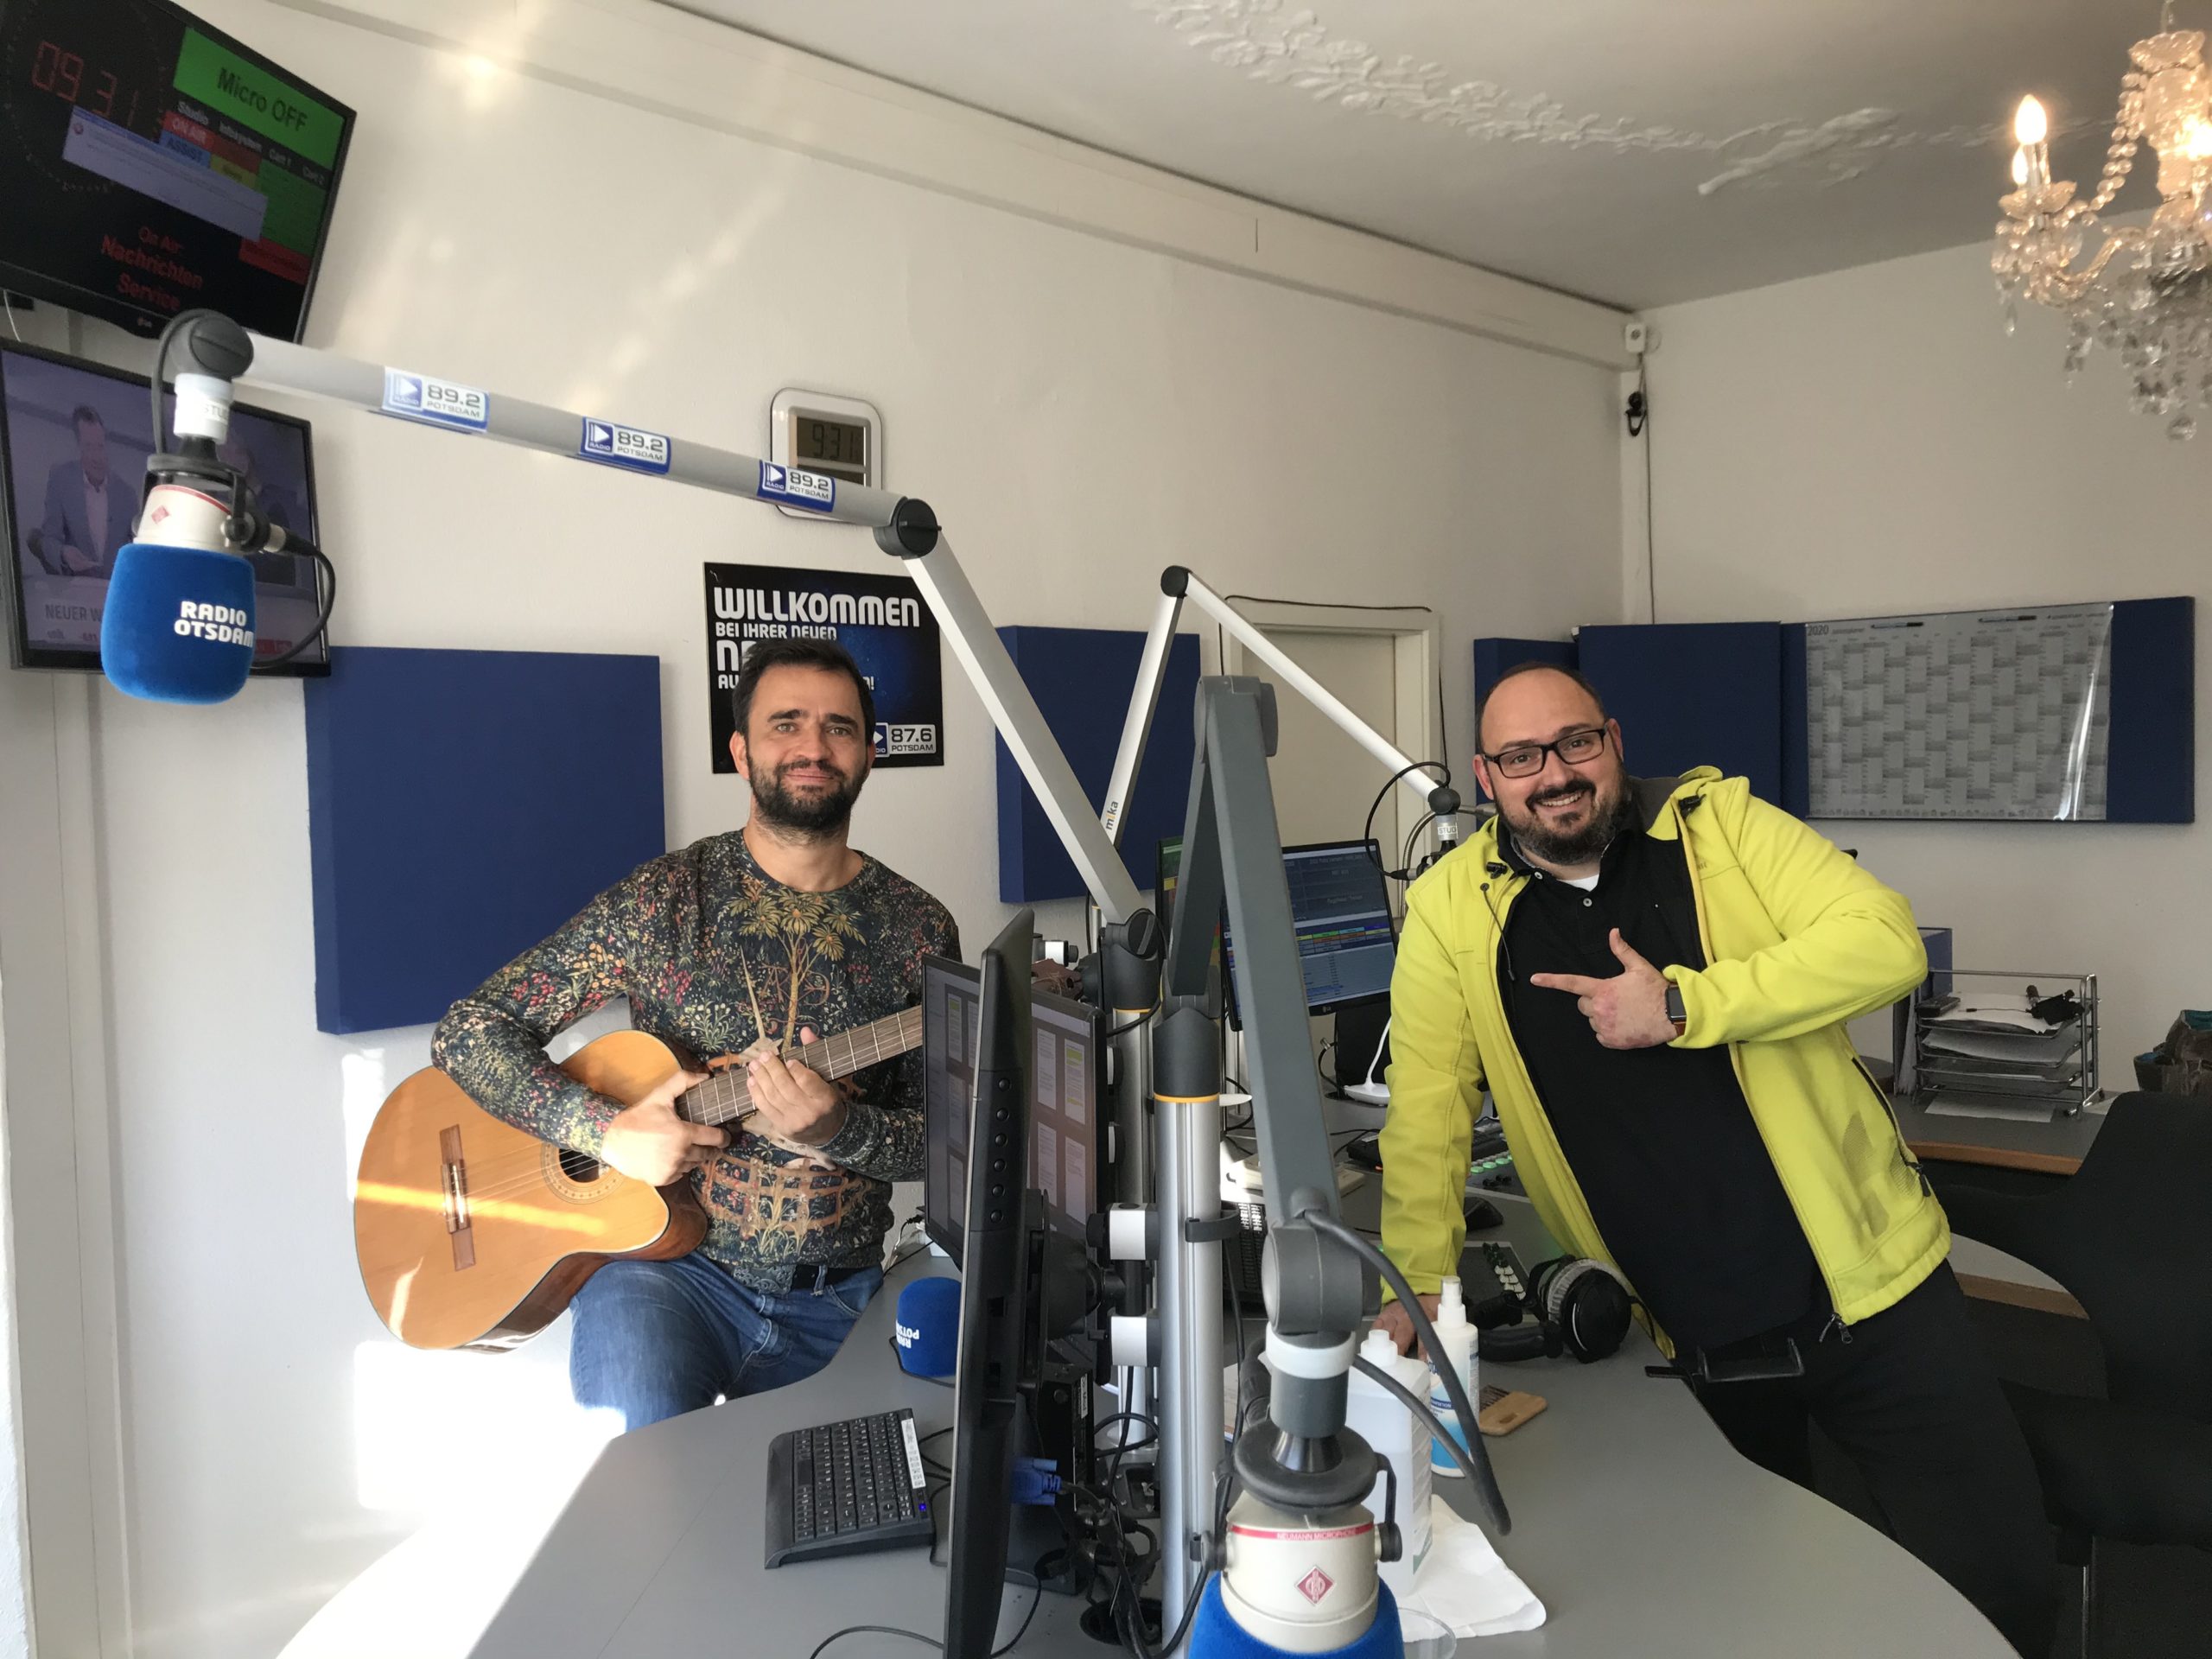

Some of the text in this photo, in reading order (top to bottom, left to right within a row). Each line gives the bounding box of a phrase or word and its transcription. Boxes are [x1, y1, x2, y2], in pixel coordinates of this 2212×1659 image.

[217, 67, 308, 131] Micro OFF
[101, 233, 203, 289] Nachrichten
[118, 271, 181, 311] Service
[428, 384, 480, 409] 89.2
[427, 400, 480, 418] POTSDAM
[589, 442, 611, 451] RADIO
[618, 430, 664, 453] 89.2
[617, 446, 664, 461] POTSDAM
[766, 480, 785, 490] RADIO
[790, 471, 830, 492] 89.2
[790, 484, 830, 499] POTSDAM
[44, 603, 87, 621] NEUER
[180, 600, 247, 627] RADIO
[714, 586, 920, 627] WILLKOMMEN
[715, 621, 837, 640] BEI IHRER NEUEN
[1807, 625, 1829, 636] 2020
[891, 728, 932, 743] 87.6
[1277, 1532, 1313, 1541] NEUMANN
